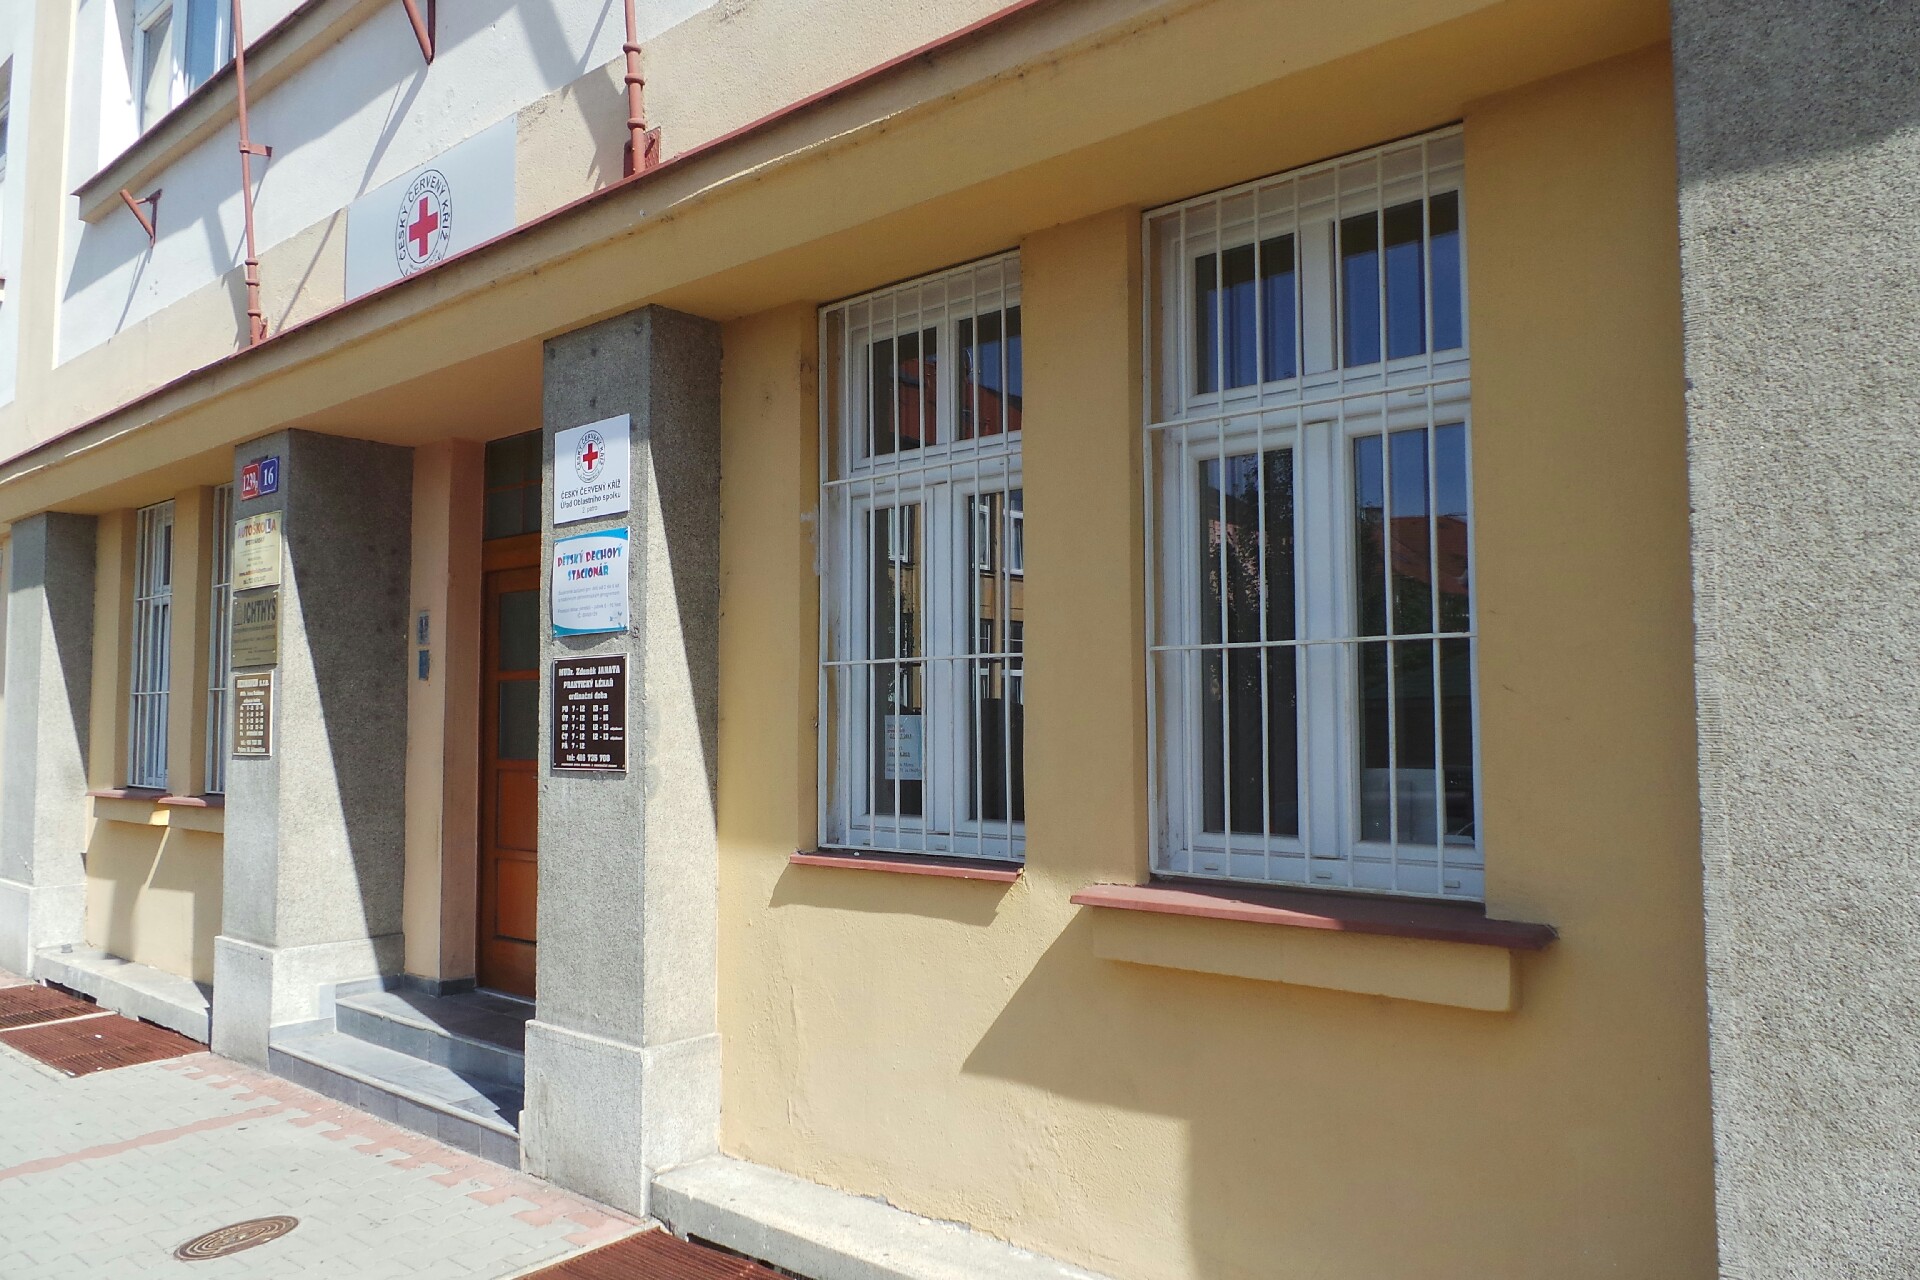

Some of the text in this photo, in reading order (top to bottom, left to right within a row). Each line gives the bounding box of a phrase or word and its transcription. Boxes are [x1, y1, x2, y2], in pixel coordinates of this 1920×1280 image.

[398, 176, 451, 261] ČESKÝ ČERVENÝ KŘÍŽ
[264, 466, 274, 486] 16
[561, 479, 621, 500] ČESKÝ ČERVENÝ KŘÍŽ
[557, 543, 623, 567] DĚTSKÝ DECHOVÝ
[567, 562, 609, 580] STACIONÁŘ
[563, 678, 613, 688] PRAKTICKÝ LÉKAŘ
[569, 691, 608, 700] ordinační doba
